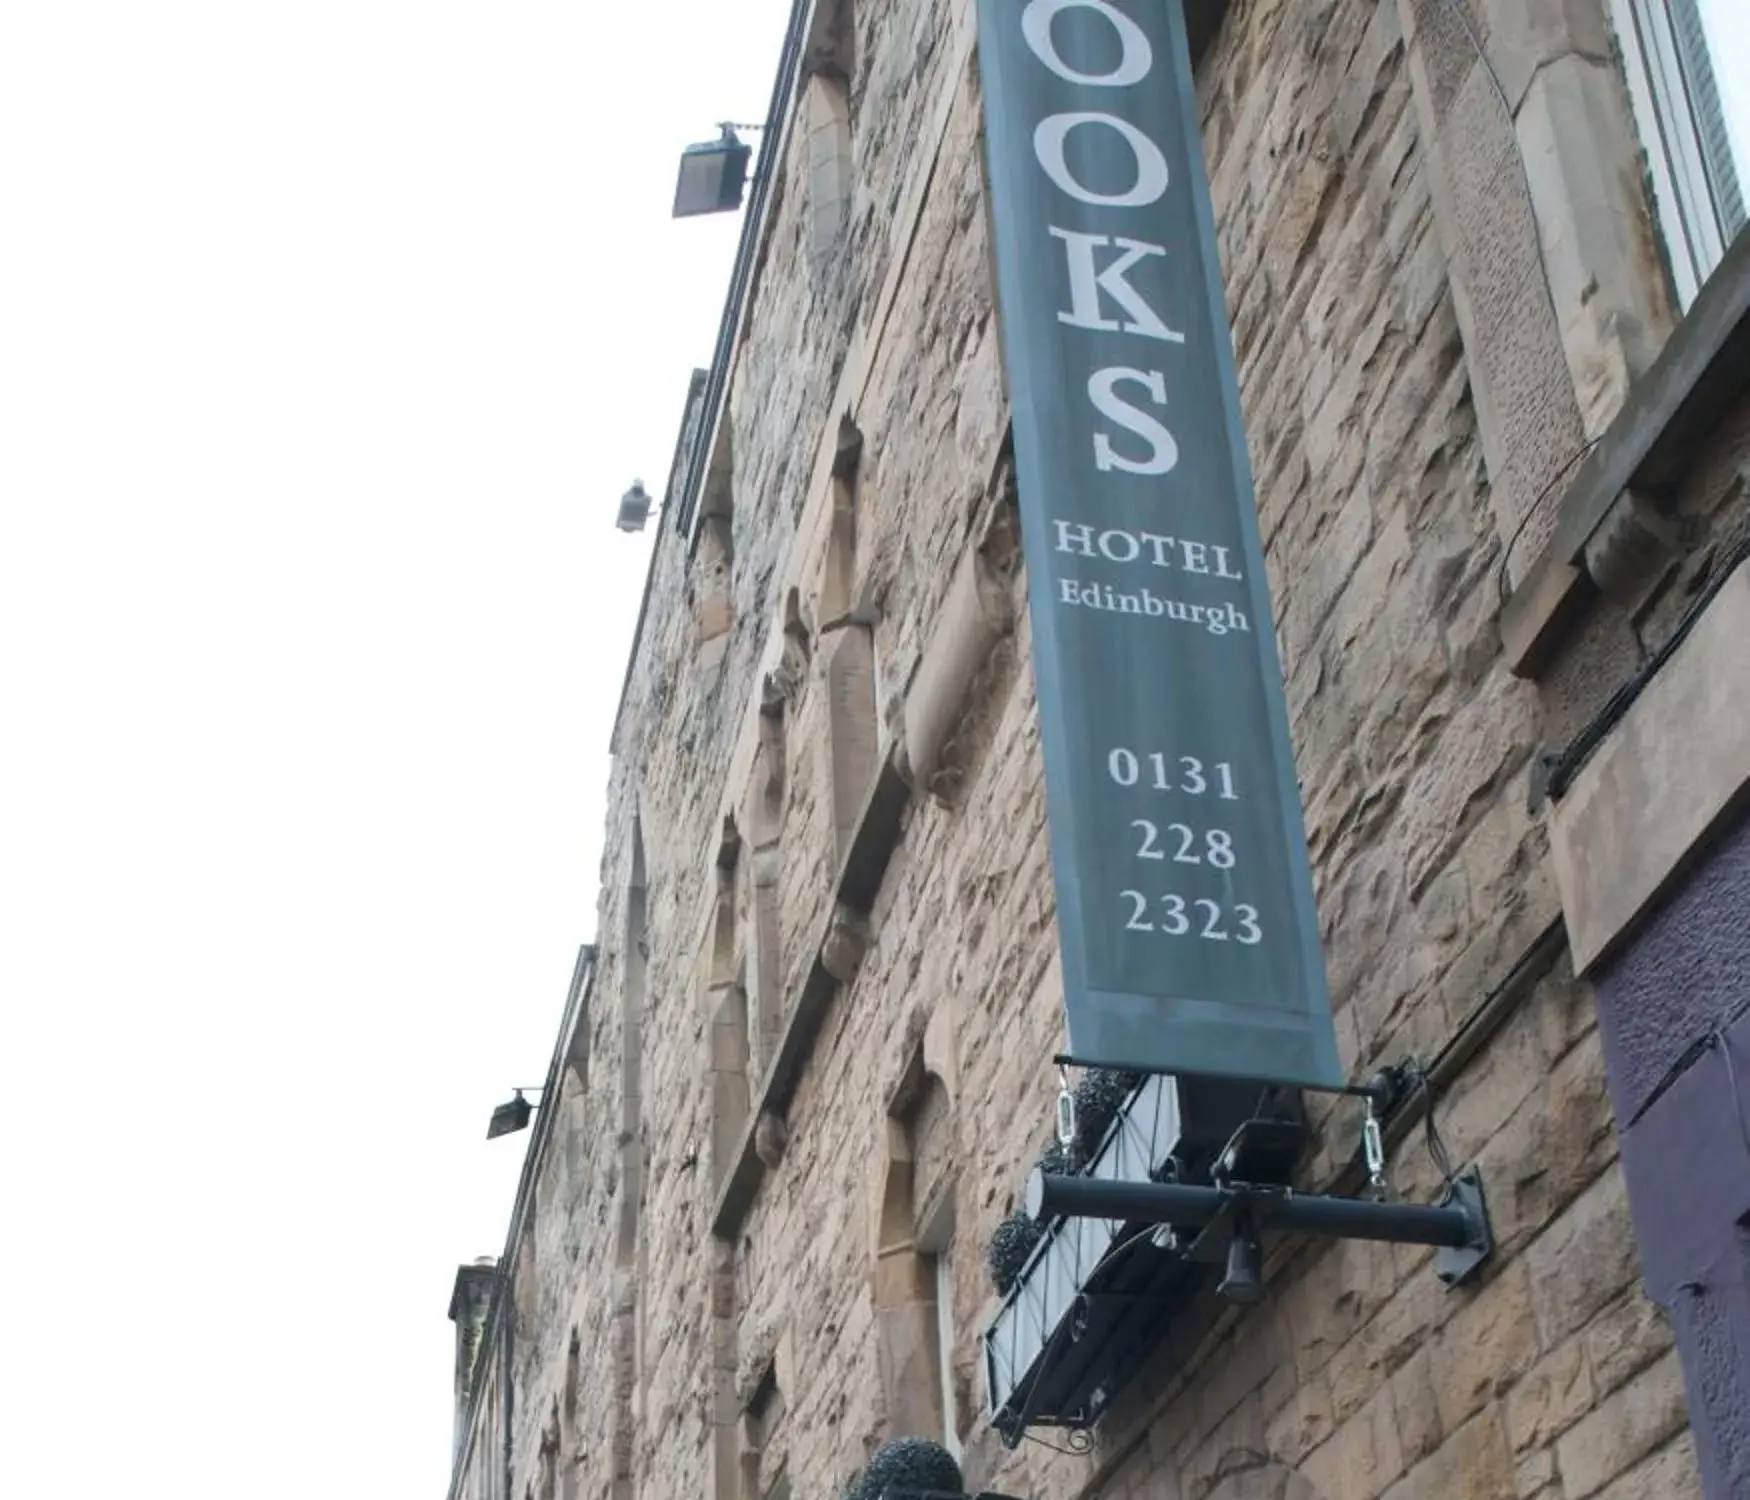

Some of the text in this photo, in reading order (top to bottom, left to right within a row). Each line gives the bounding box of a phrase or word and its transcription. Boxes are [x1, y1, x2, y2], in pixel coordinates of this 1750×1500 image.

[1053, 519, 1243, 580] HOTEL
[1057, 578, 1249, 635] Edinburgh
[1108, 748, 1239, 800] 0131
[1130, 819, 1236, 868] 228
[1119, 890, 1262, 945] 2323
